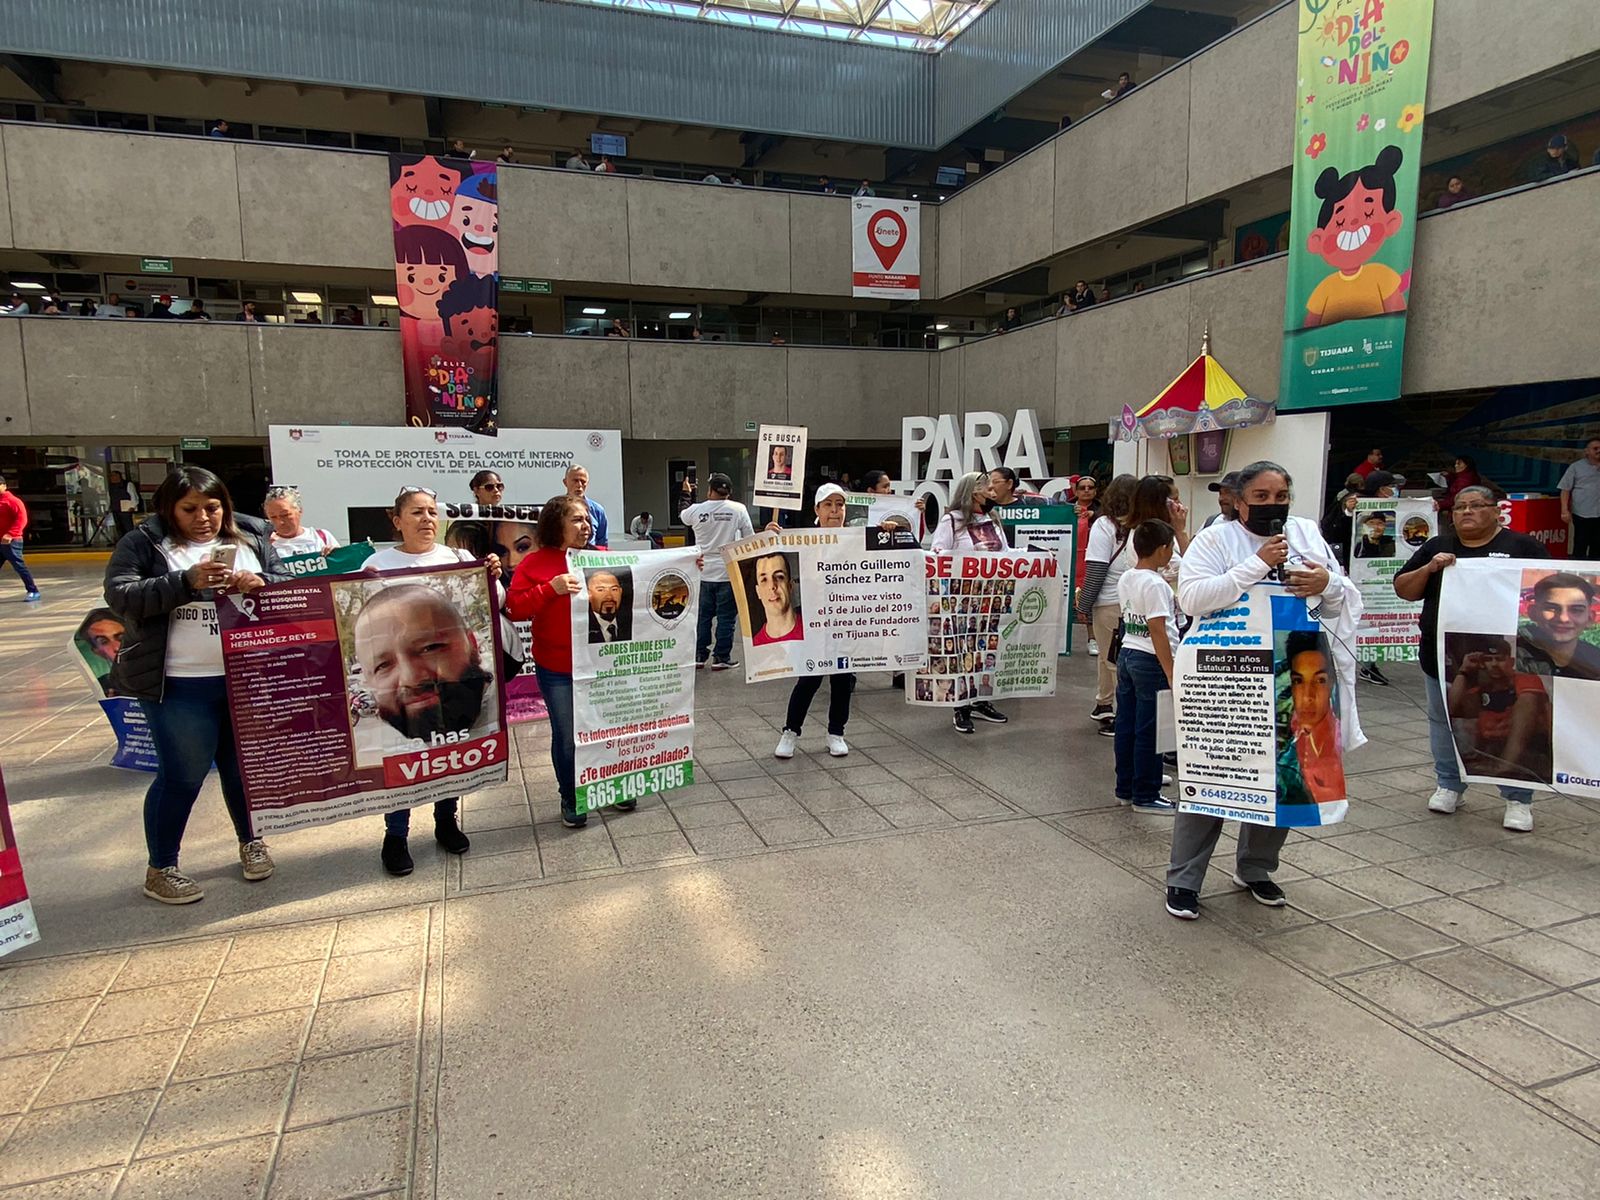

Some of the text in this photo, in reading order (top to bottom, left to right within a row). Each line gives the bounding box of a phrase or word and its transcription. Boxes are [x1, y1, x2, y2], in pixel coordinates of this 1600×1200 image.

[1338, 40, 1409, 85] NIÑO
[1320, 346, 1354, 357] TIJUANA
[442, 392, 484, 410] NIÑO
[763, 433, 801, 443] SE BUSCA
[901, 409, 1050, 480] PARA
[334, 448, 574, 460] TOMA DE PROTESTA DEL COMITÉ INTERNO
[317, 460, 333, 468] DE
[338, 458, 412, 469] PROTECCIÓN
[416, 460, 444, 469] CIVIL
[450, 460, 464, 469] DE
[468, 460, 515, 469] PALACIO
[1000, 507, 1040, 519] busca
[734, 538, 766, 556] FICHA
[781, 534, 839, 546] BÚSQUEDA
[588, 557, 604, 566] HAZ
[607, 554, 639, 565] VISTO?
[817, 558, 911, 572] Ramón Guillemo
[925, 556, 1057, 579] SE BUSCAN
[825, 573, 904, 585] Sánchez Parra
[828, 592, 860, 603] Última
[880, 592, 902, 601] visto
[176, 608, 198, 620] SIGO
[818, 603, 913, 615] el 5 de Julio del 2019
[810, 615, 920, 629] en el área de Fundadores
[230, 629, 274, 640] JOSE LUIS
[230, 633, 316, 648] HERNANDEZ REYES
[832, 629, 900, 641] en Tijuana B.C.
[598, 637, 676, 657] ¿SABES DONDE ESTÁ?
[1005, 643, 1042, 652] Cualquier
[613, 651, 662, 667] ¿VISTE ALGO?
[818, 660, 833, 668] 089
[1004, 660, 1016, 670] por
[615, 668, 631, 676] Juan
[578, 714, 689, 743] Tu información será anónima
[430, 728, 470, 746] has
[606, 730, 668, 749] Si fuera uno de
[618, 742, 656, 756] los tuyos
[399, 739, 497, 780] visto?
[580, 767, 598, 784] ¿Te
[650, 746, 689, 766] callado?
[586, 764, 684, 810] 665-149-3795
[1200, 788, 1267, 805] 6648223529
[285, 808, 309, 818] ALGUNA
[1190, 804, 1270, 822] llamada anónima
